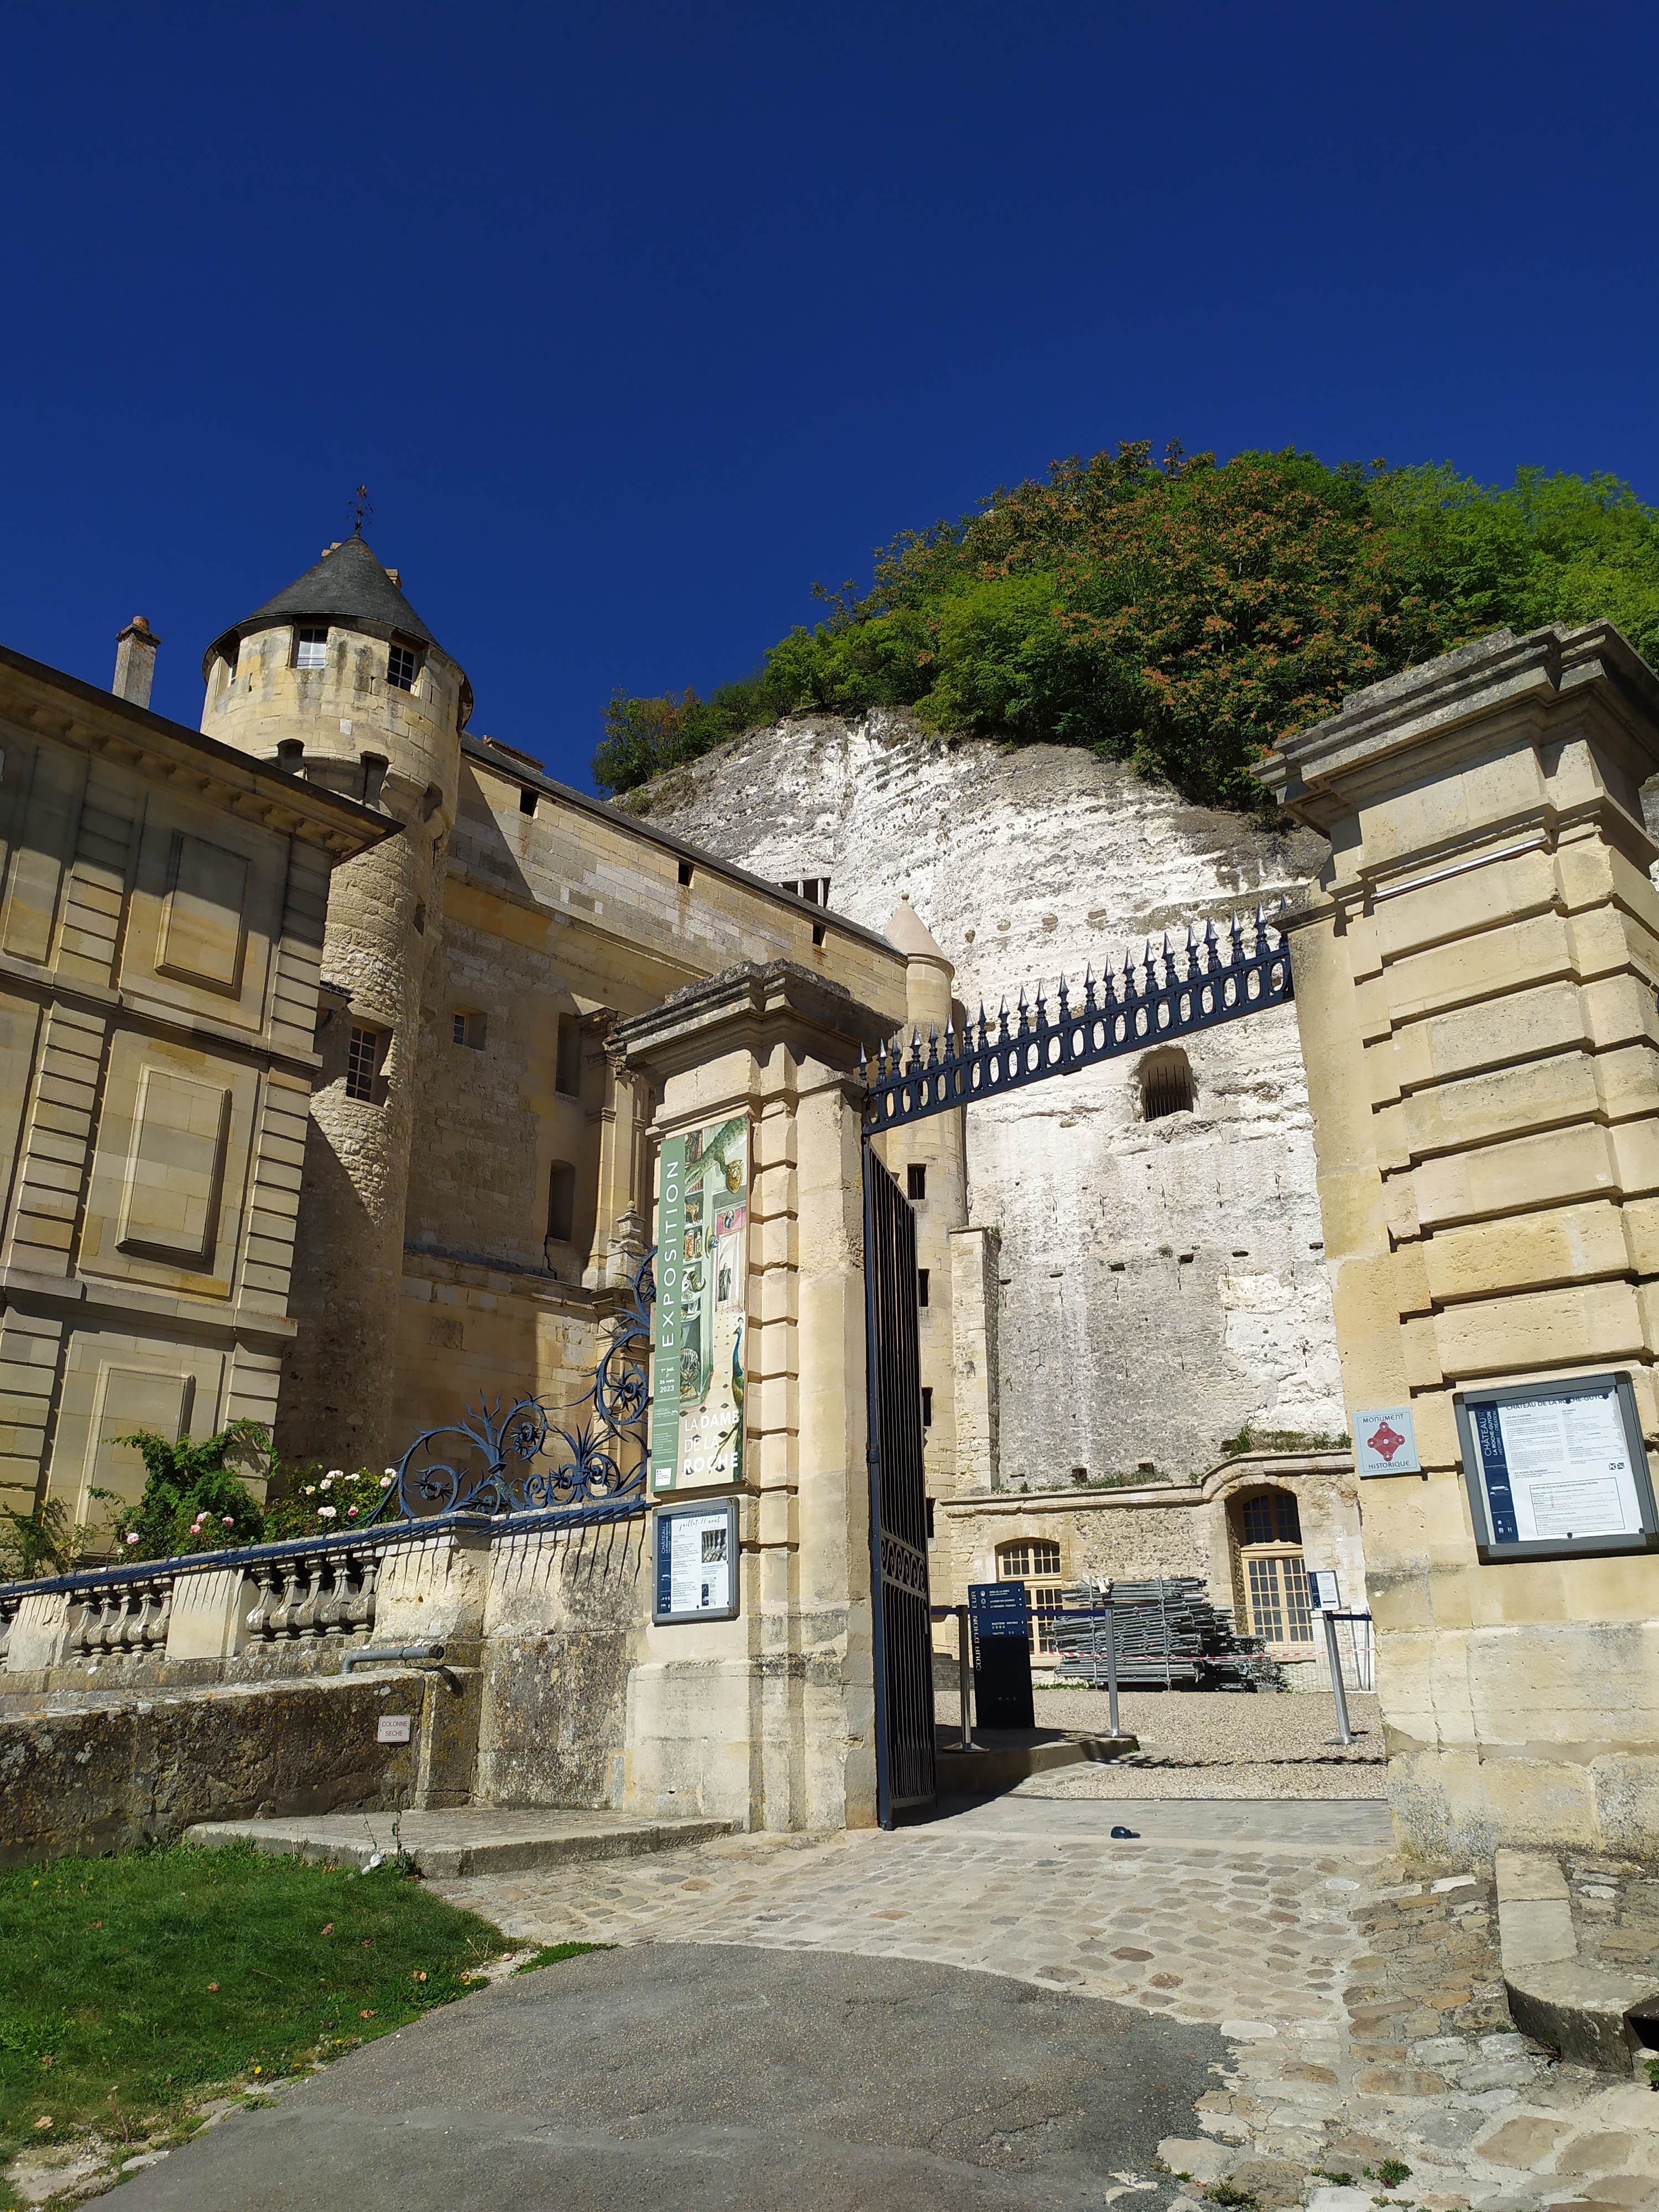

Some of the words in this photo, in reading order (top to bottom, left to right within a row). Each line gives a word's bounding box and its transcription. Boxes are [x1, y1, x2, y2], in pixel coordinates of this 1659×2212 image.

[662, 1161, 679, 1348] EXPOSITION
[659, 1385, 674, 1393] 2023
[1506, 1401, 1536, 1411] CHÂTEAU
[685, 1418, 698, 1431] LA
[701, 1410, 739, 1429] DAME
[1363, 1414, 1404, 1423] MONUMENT
[1479, 1417, 1491, 1456] CHÂTEAU
[1486, 1411, 1496, 1448] ROCHE-GUYON
[684, 1437, 701, 1453] DE
[704, 1435, 719, 1449] LA
[684, 1451, 738, 1474] ROCHE
[1369, 1460, 1410, 1469] HISTORIQUE
[679, 1519, 697, 1532] juillet
